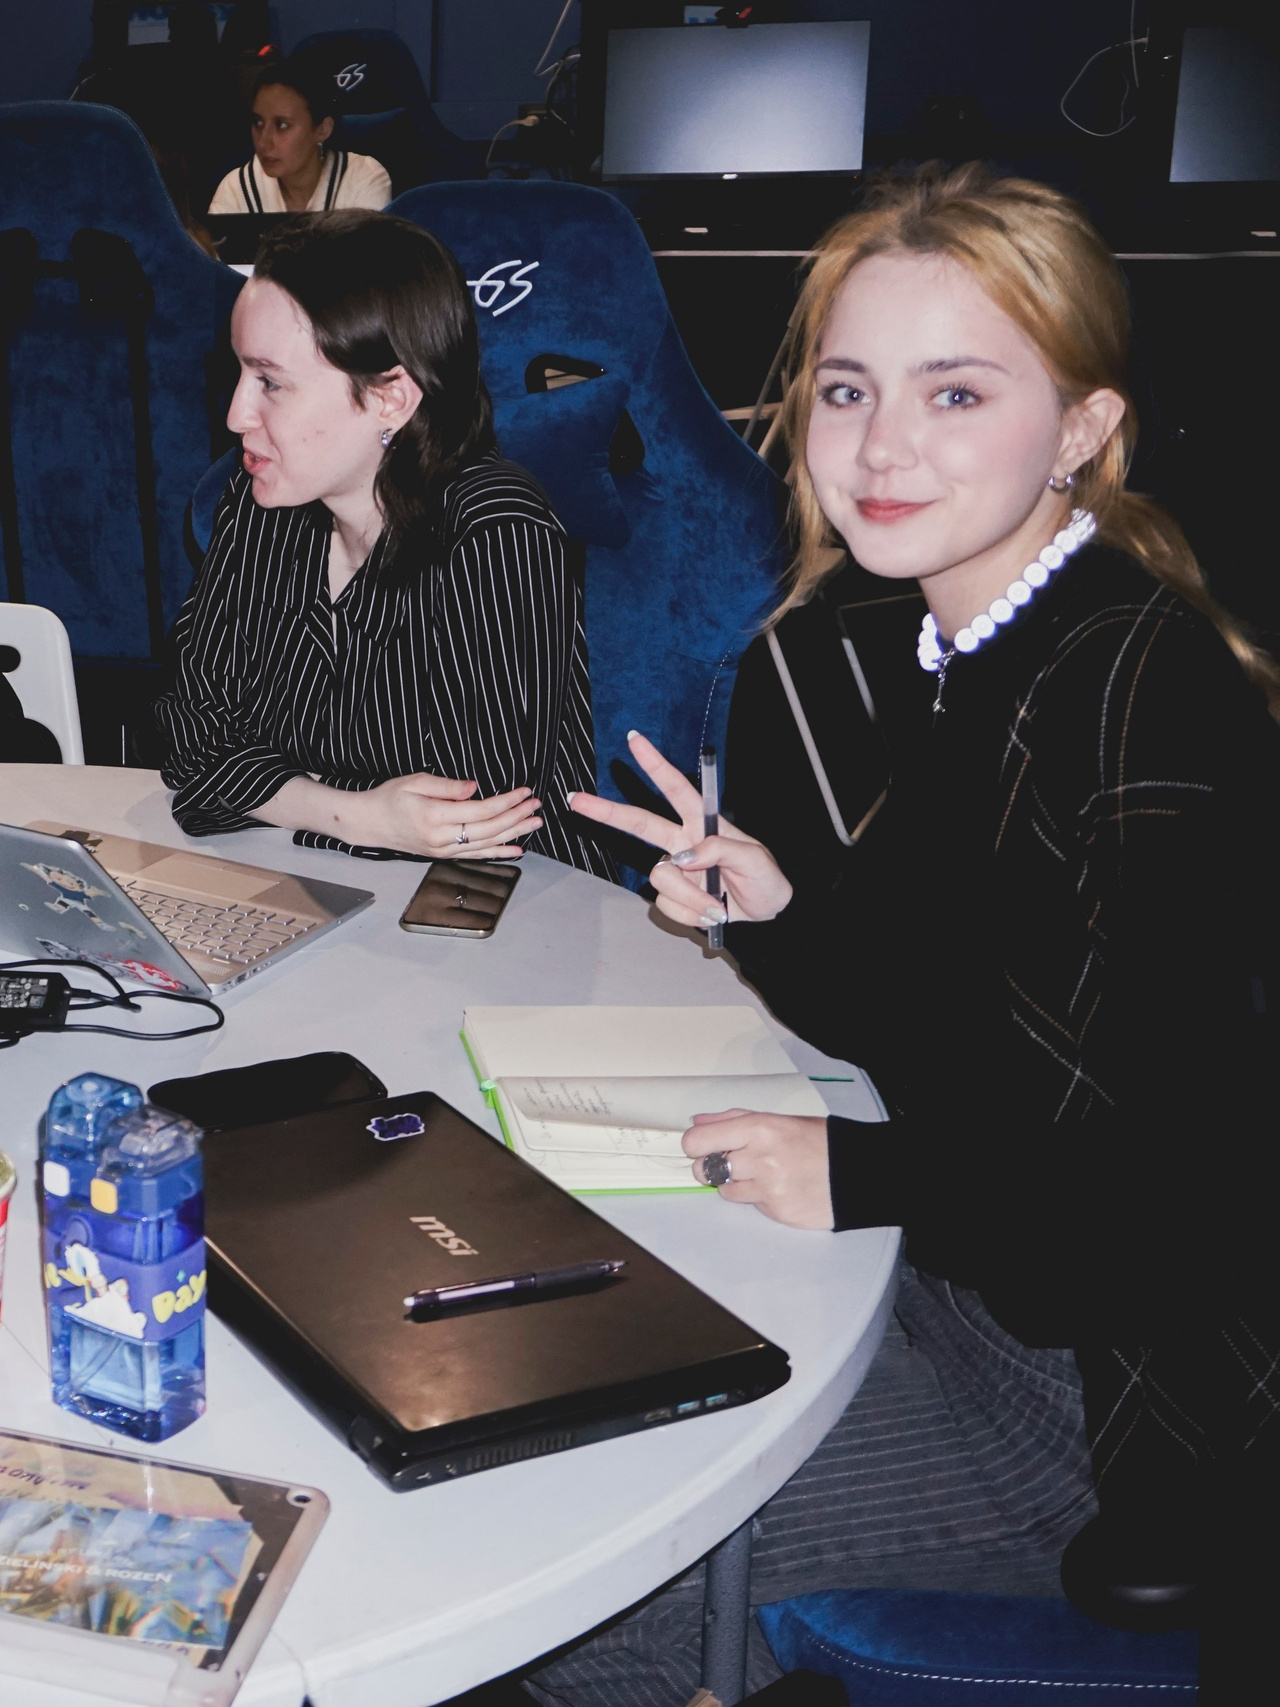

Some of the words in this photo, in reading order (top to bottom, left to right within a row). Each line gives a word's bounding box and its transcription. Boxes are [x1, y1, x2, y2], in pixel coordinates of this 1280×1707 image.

[409, 1216, 479, 1256] msi
[85, 1565, 101, 1576] &
[104, 1567, 174, 1584] ROZEN
